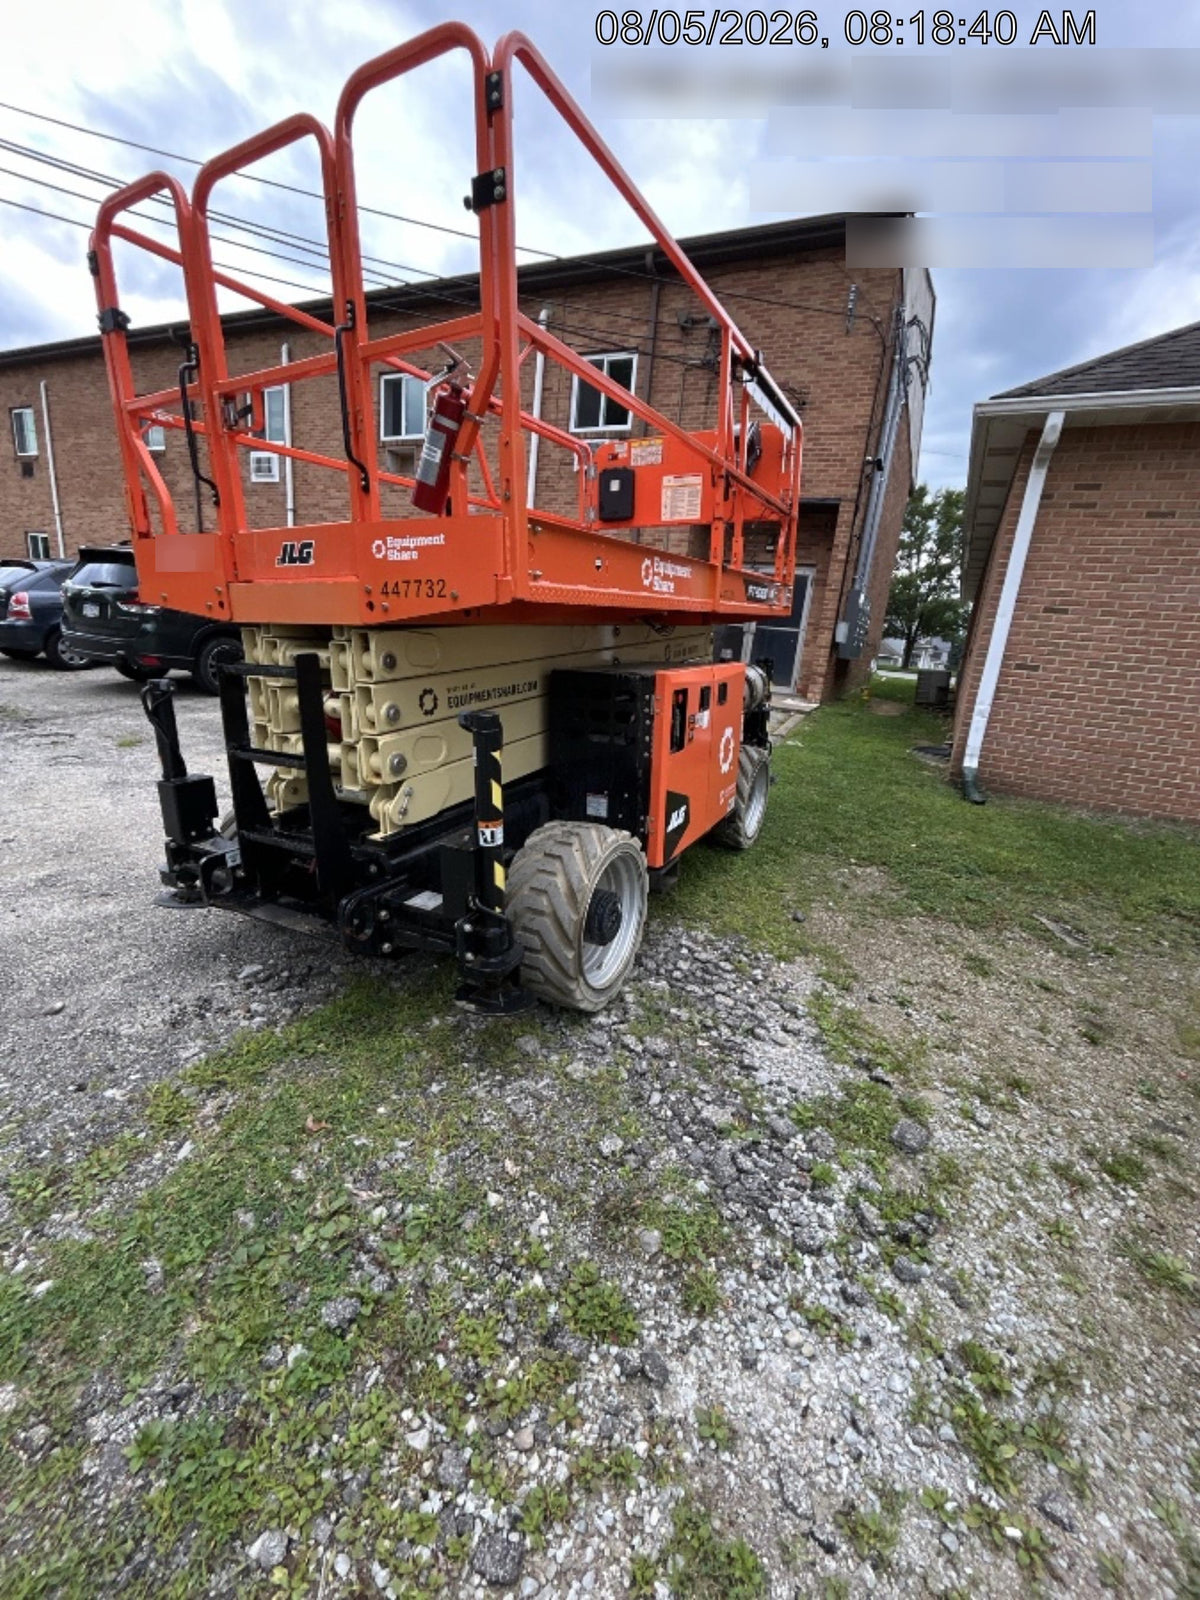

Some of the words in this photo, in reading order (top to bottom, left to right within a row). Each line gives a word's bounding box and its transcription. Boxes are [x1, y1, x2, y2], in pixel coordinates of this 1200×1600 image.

[386, 533, 446, 549] Equipment
[275, 540, 315, 567] JLG
[387, 549, 419, 561] Share
[380, 579, 447, 599] 447732
